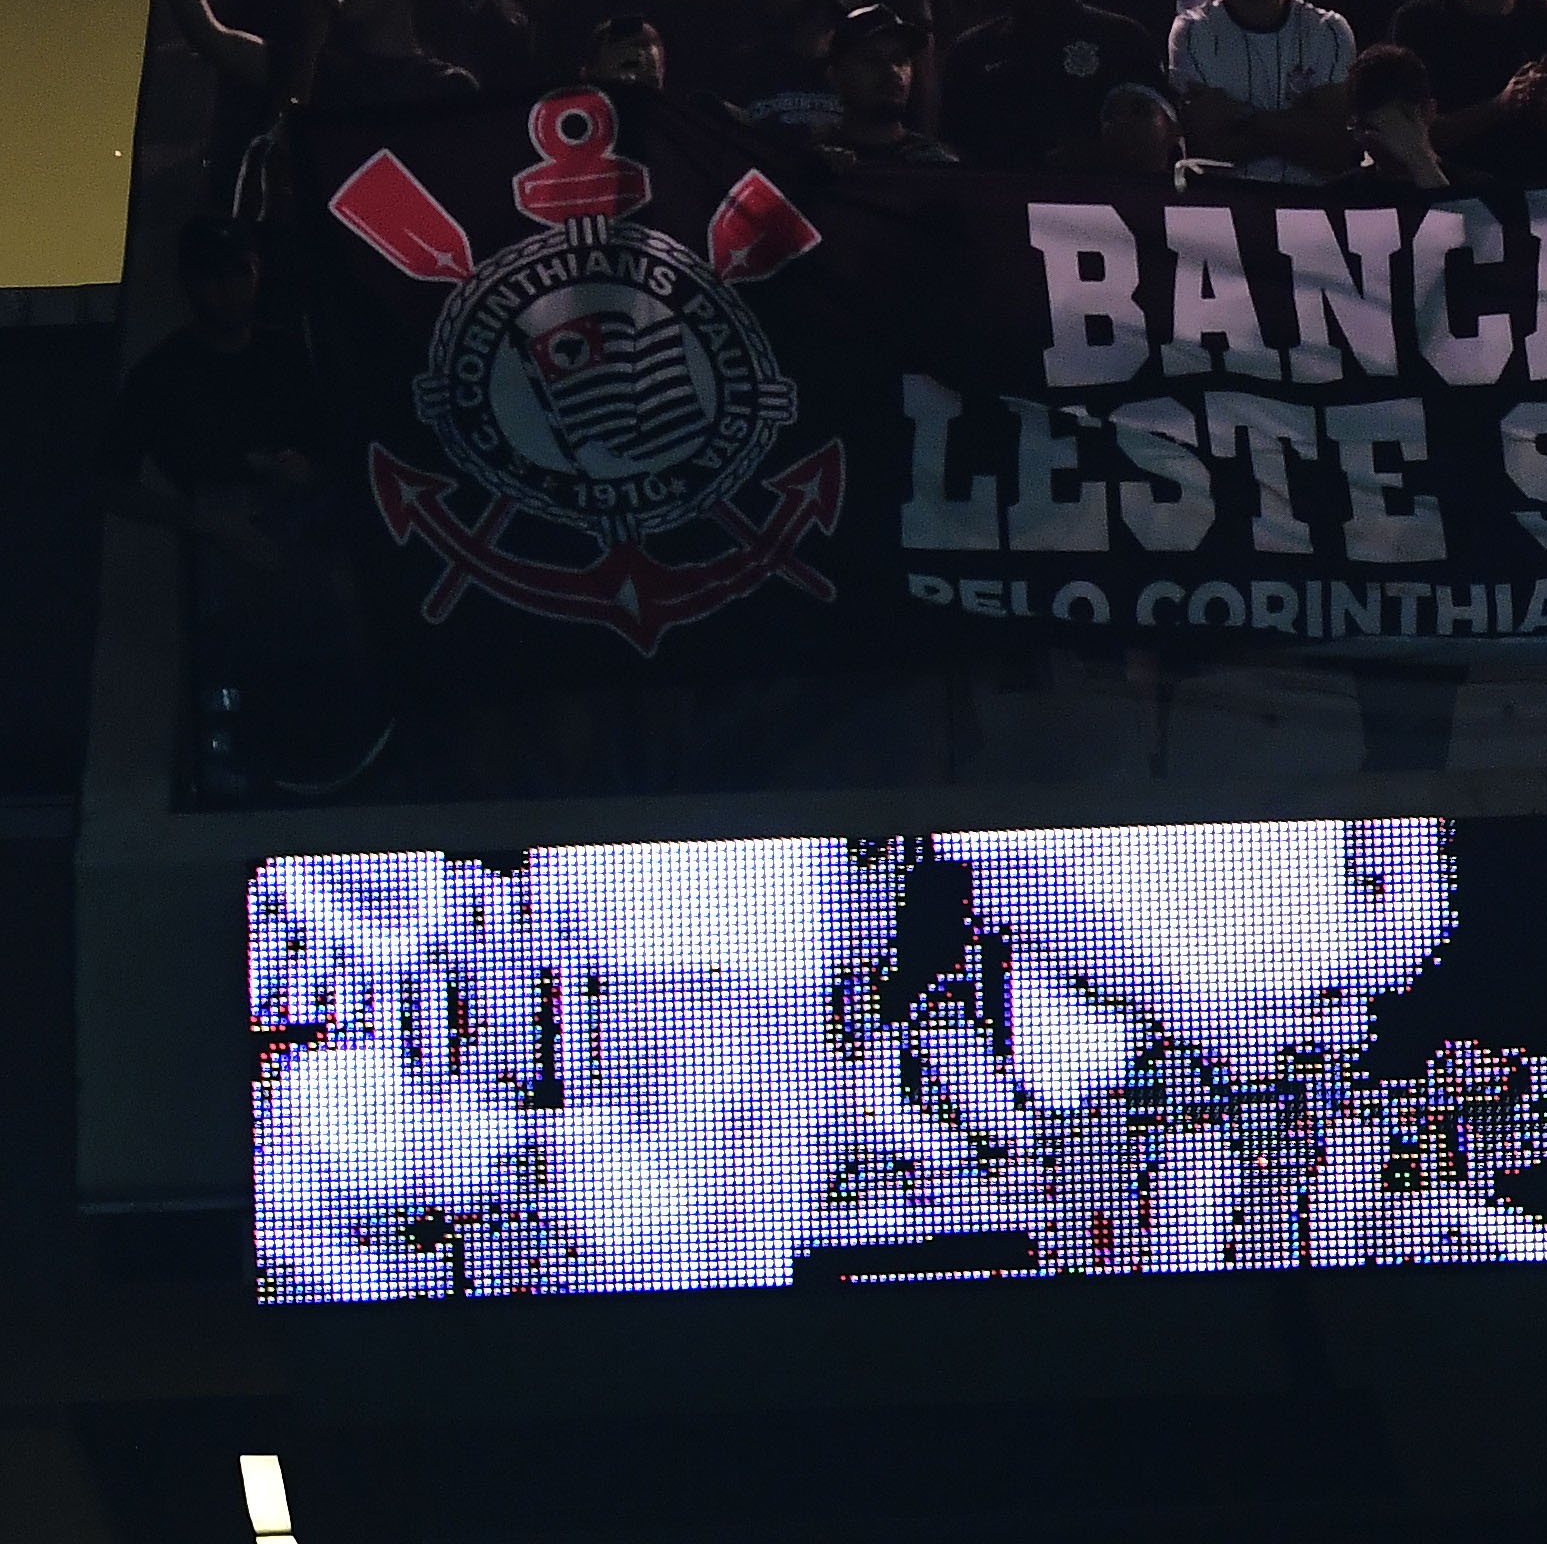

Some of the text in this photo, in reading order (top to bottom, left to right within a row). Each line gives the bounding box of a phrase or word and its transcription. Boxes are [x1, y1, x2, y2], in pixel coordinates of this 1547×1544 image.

[456, 249, 677, 408] CORINTHIANS
[683, 294, 752, 470] PAULISTA
[573, 470, 668, 509] 1910
[900, 373, 1448, 562] LESTE
[907, 573, 1110, 625] PELO
